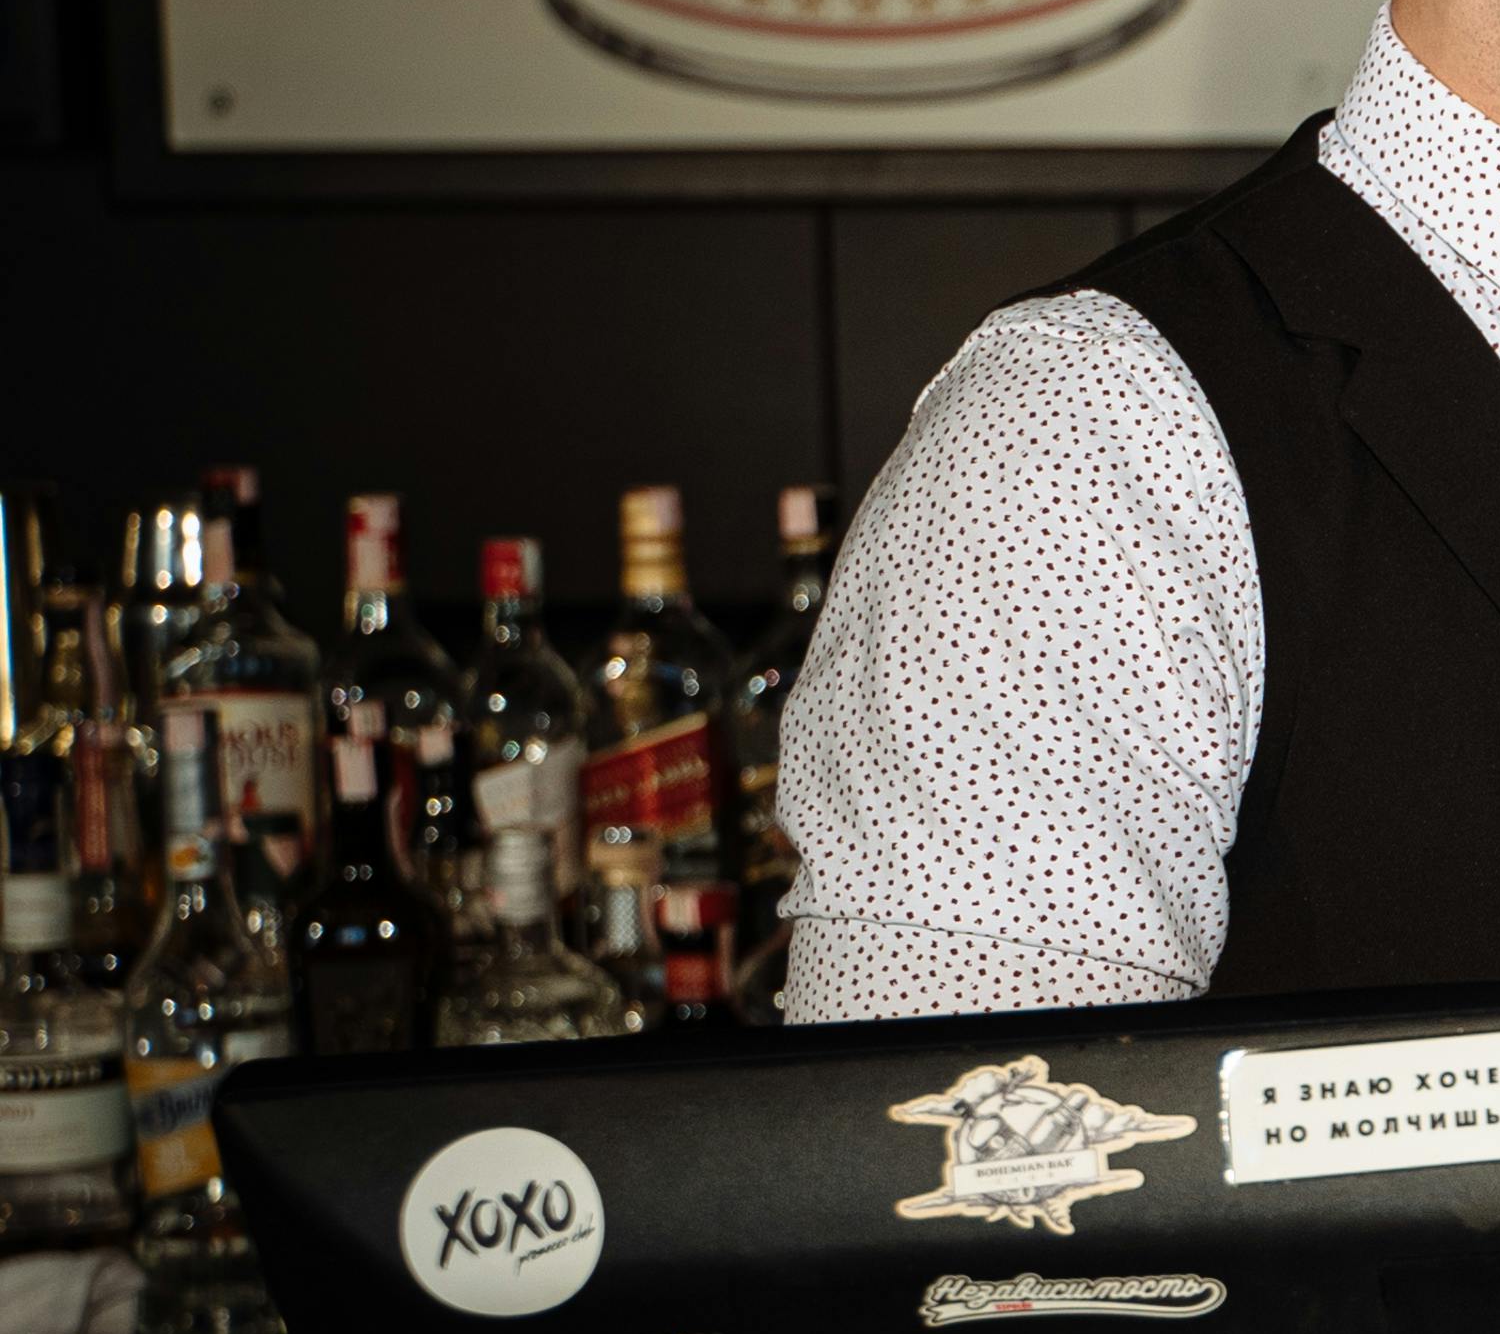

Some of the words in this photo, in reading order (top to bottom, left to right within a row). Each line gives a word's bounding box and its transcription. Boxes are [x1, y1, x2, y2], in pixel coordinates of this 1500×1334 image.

[1262, 1086, 1278, 1105] Я
[1299, 1077, 1393, 1102] ЗНАЮ
[1265, 1125, 1308, 1146] НО
[434, 1178, 577, 1270] XOXO
[933, 1275, 1205, 1309] Независимость
